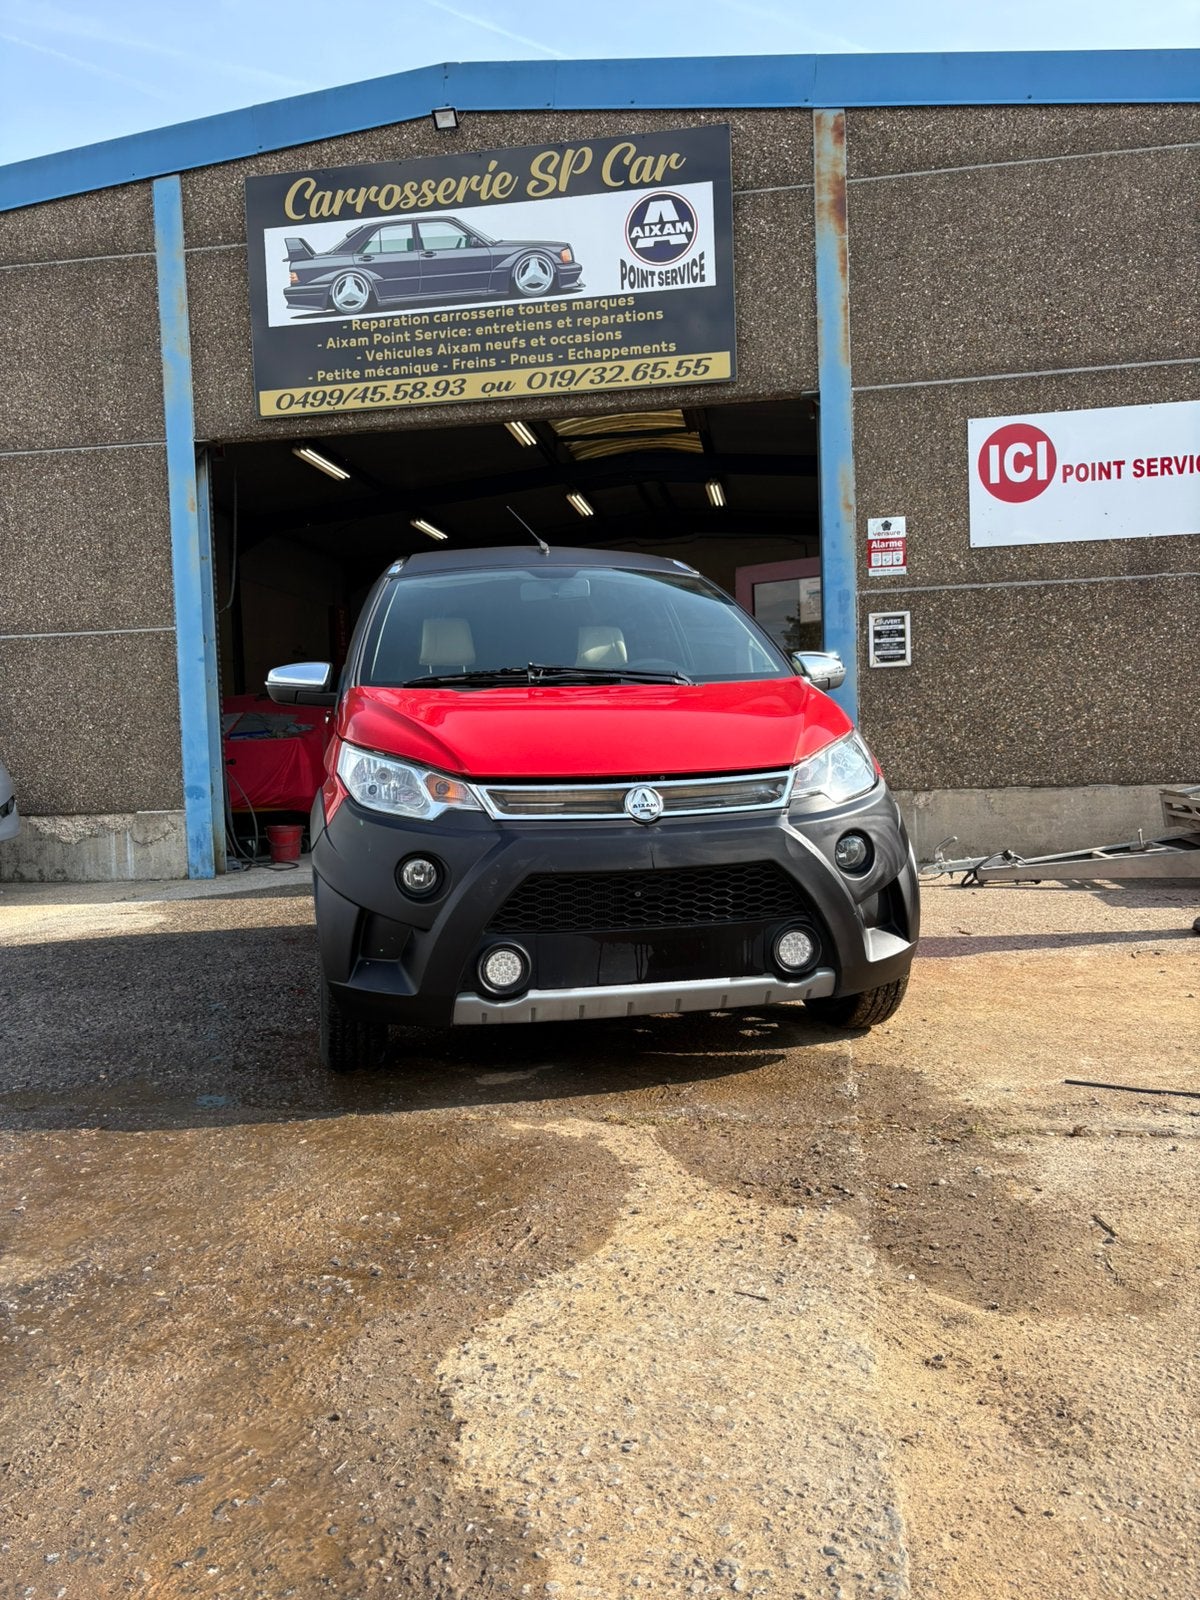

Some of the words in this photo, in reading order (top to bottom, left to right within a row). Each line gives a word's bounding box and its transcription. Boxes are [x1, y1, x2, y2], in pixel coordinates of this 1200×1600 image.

[284, 159, 519, 220] Carrosserie
[526, 146, 593, 197] SP
[601, 142, 687, 187] Car
[630, 221, 693, 238] AIXAM
[620, 258, 656, 290] POINT
[658, 251, 706, 287] SERVICE
[326, 336, 369, 350] Aixam
[373, 331, 411, 345] Point
[415, 326, 472, 342] Service:
[475, 319, 553, 335] entretiens
[556, 315, 573, 328] et
[577, 309, 664, 326] reparations
[351, 314, 430, 332] Reparation
[433, 306, 515, 323] carrosserie
[518, 301, 567, 316] toutes
[572, 295, 635, 311] marques
[317, 368, 360, 382] Petite
[364, 362, 439, 378] mécanique
[452, 357, 497, 370] Freins
[510, 352, 554, 365] Pneus
[567, 341, 677, 360] Echappements
[365, 346, 433, 362] Vehicules
[437, 341, 481, 355] Aixam
[485, 337, 526, 351] neufs
[530, 335, 546, 347] et
[550, 329, 622, 345] occasions
[275, 378, 467, 410] 0499/45.58.93
[481, 380, 516, 393] ou
[526, 357, 712, 390] 019/32.65.55
[989, 440, 1047, 484] ICI
[1062, 460, 1126, 483] POINT
[871, 540, 903, 549] Alarme
